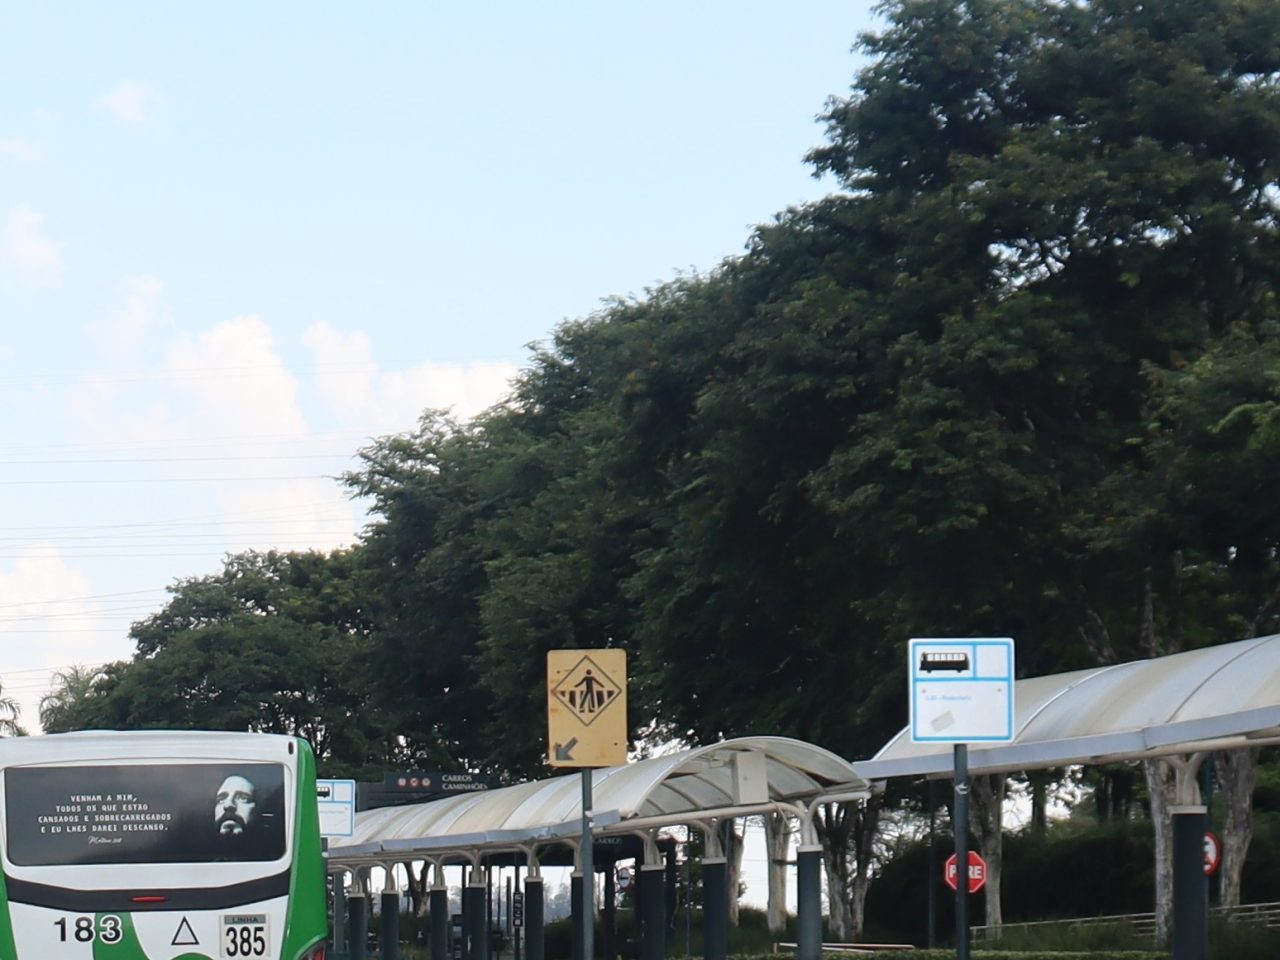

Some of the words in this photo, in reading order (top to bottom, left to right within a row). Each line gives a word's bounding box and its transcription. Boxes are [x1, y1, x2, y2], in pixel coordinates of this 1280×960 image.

[442, 774, 472, 782] CARROS
[116, 794, 137, 802] MIM,
[38, 815, 79, 823] CANSADOS
[95, 813, 171, 821] SOBRECARREGADOS
[92, 824, 117, 832] DAREI
[949, 864, 983, 879] PRE
[53, 916, 122, 942] 183
[226, 926, 266, 957] 385
